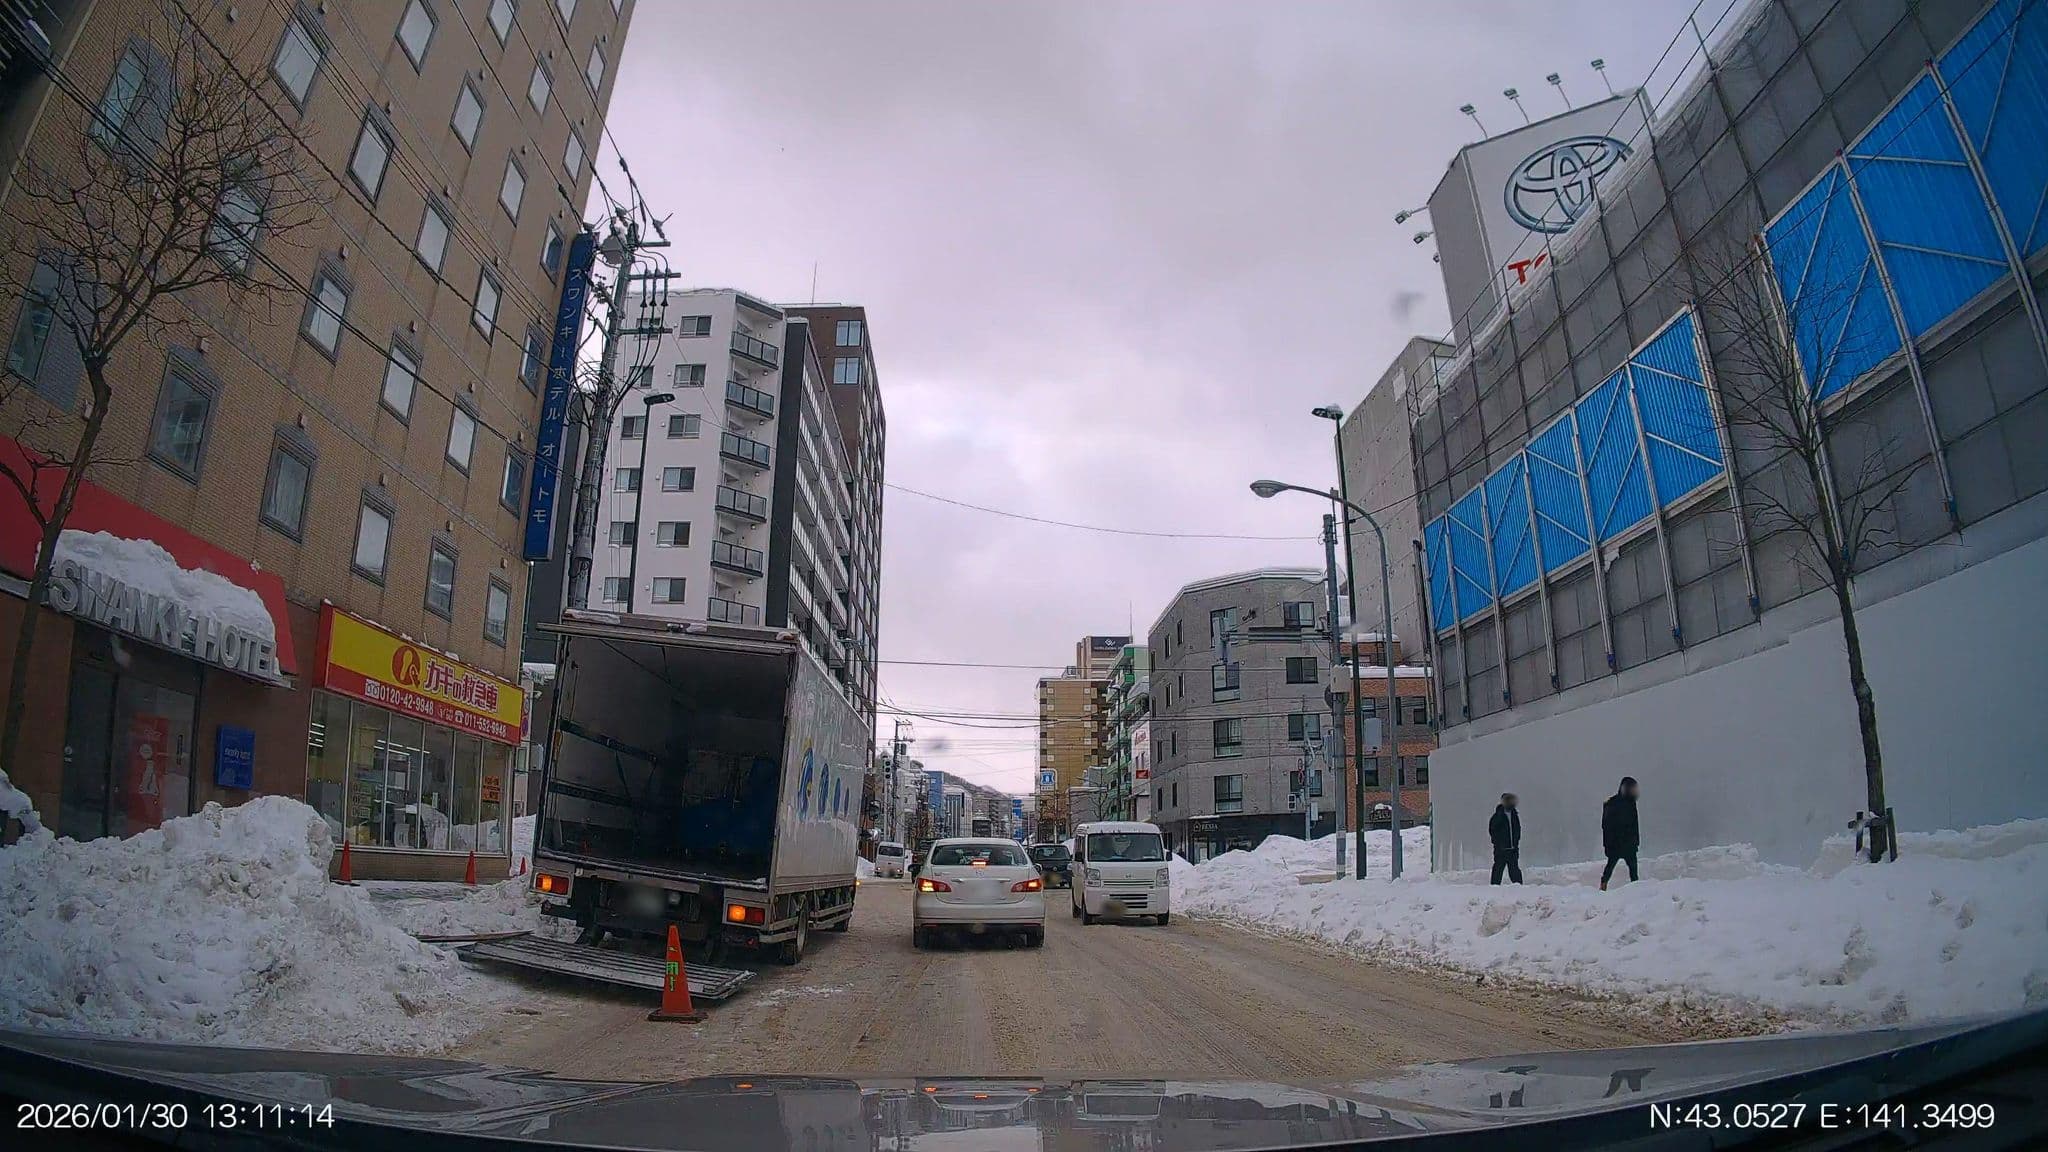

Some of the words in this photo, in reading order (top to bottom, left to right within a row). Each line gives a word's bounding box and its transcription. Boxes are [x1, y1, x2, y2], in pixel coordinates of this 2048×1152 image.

[49, 559, 193, 648] SWANKY
[424, 657, 498, 713] カギの救急車
